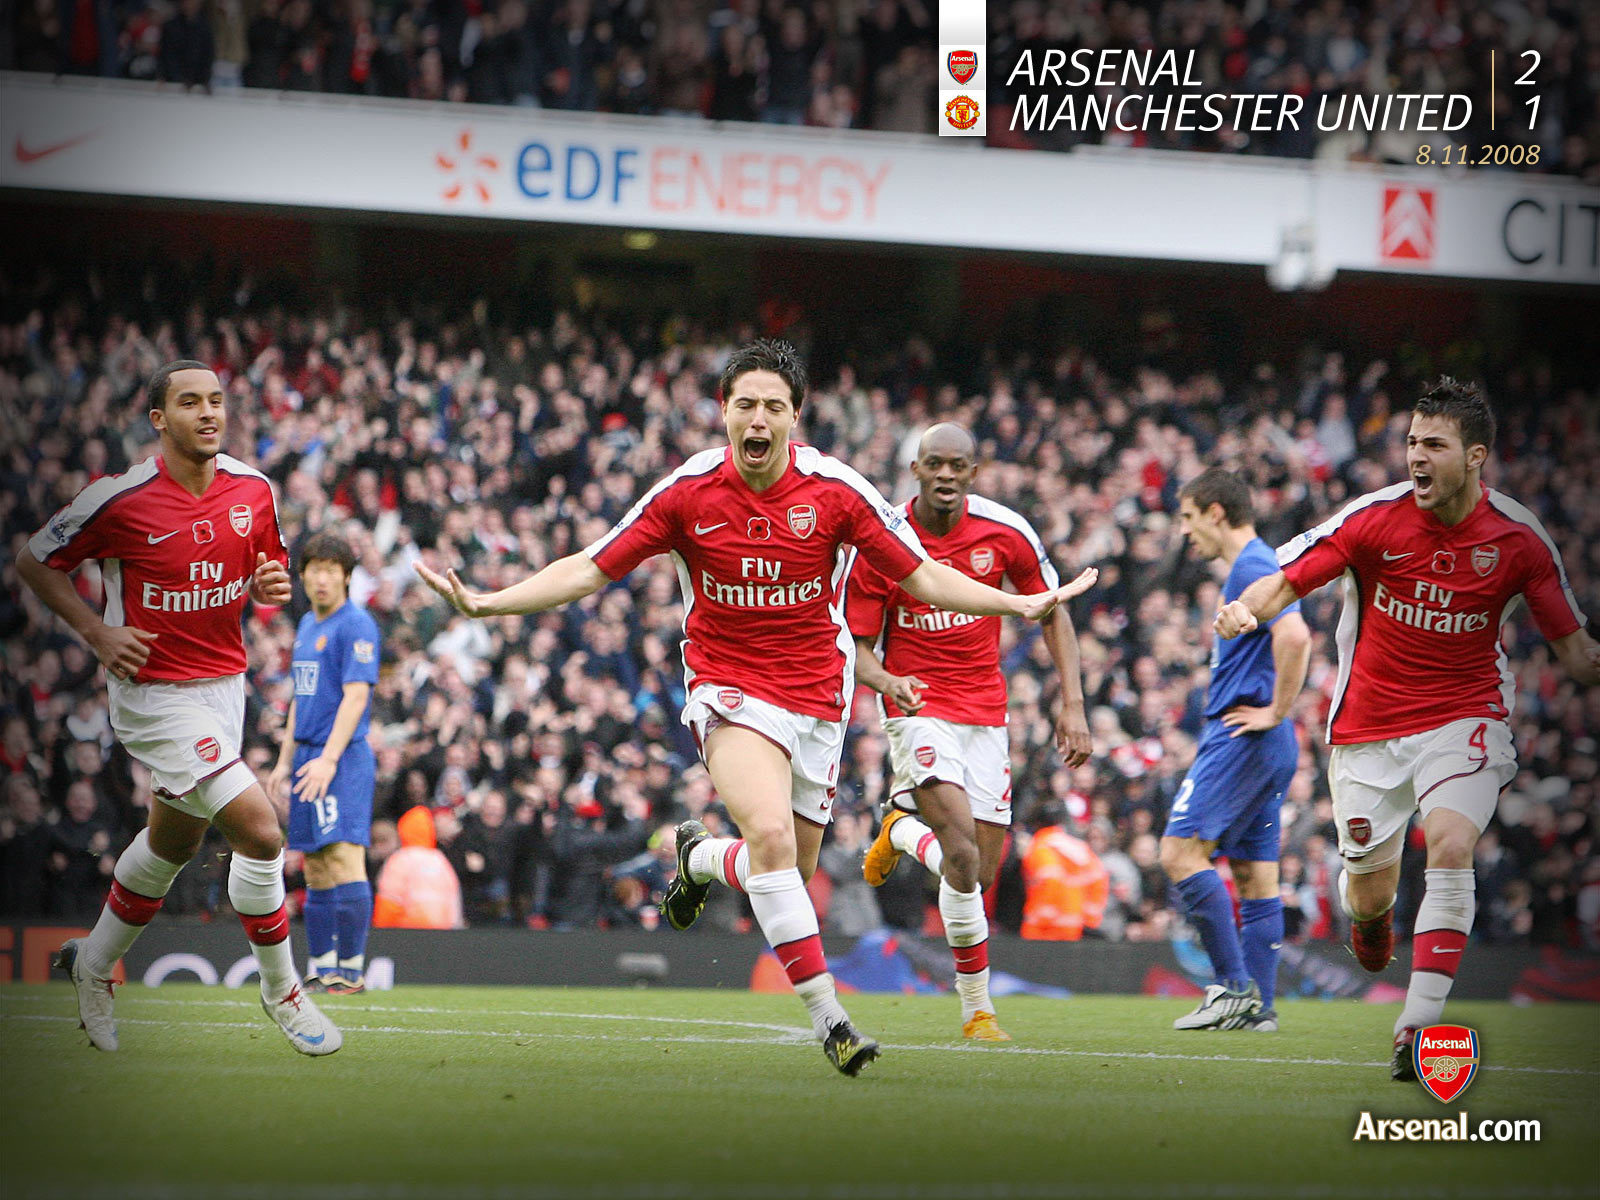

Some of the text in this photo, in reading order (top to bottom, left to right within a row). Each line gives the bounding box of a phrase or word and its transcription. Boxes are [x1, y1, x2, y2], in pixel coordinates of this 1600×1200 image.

[648, 147, 893, 223] ENERGY
[189, 560, 224, 583] Fly
[741, 557, 782, 582] Fly
[142, 576, 244, 612] Emirate
[701, 569, 822, 607] Emirates
[1414, 580, 1455, 609] Fly
[1373, 582, 1489, 634] Emirates
[1468, 722, 1488, 754] 4
[314, 795, 339, 827] 13
[1172, 778, 1194, 812] 2
